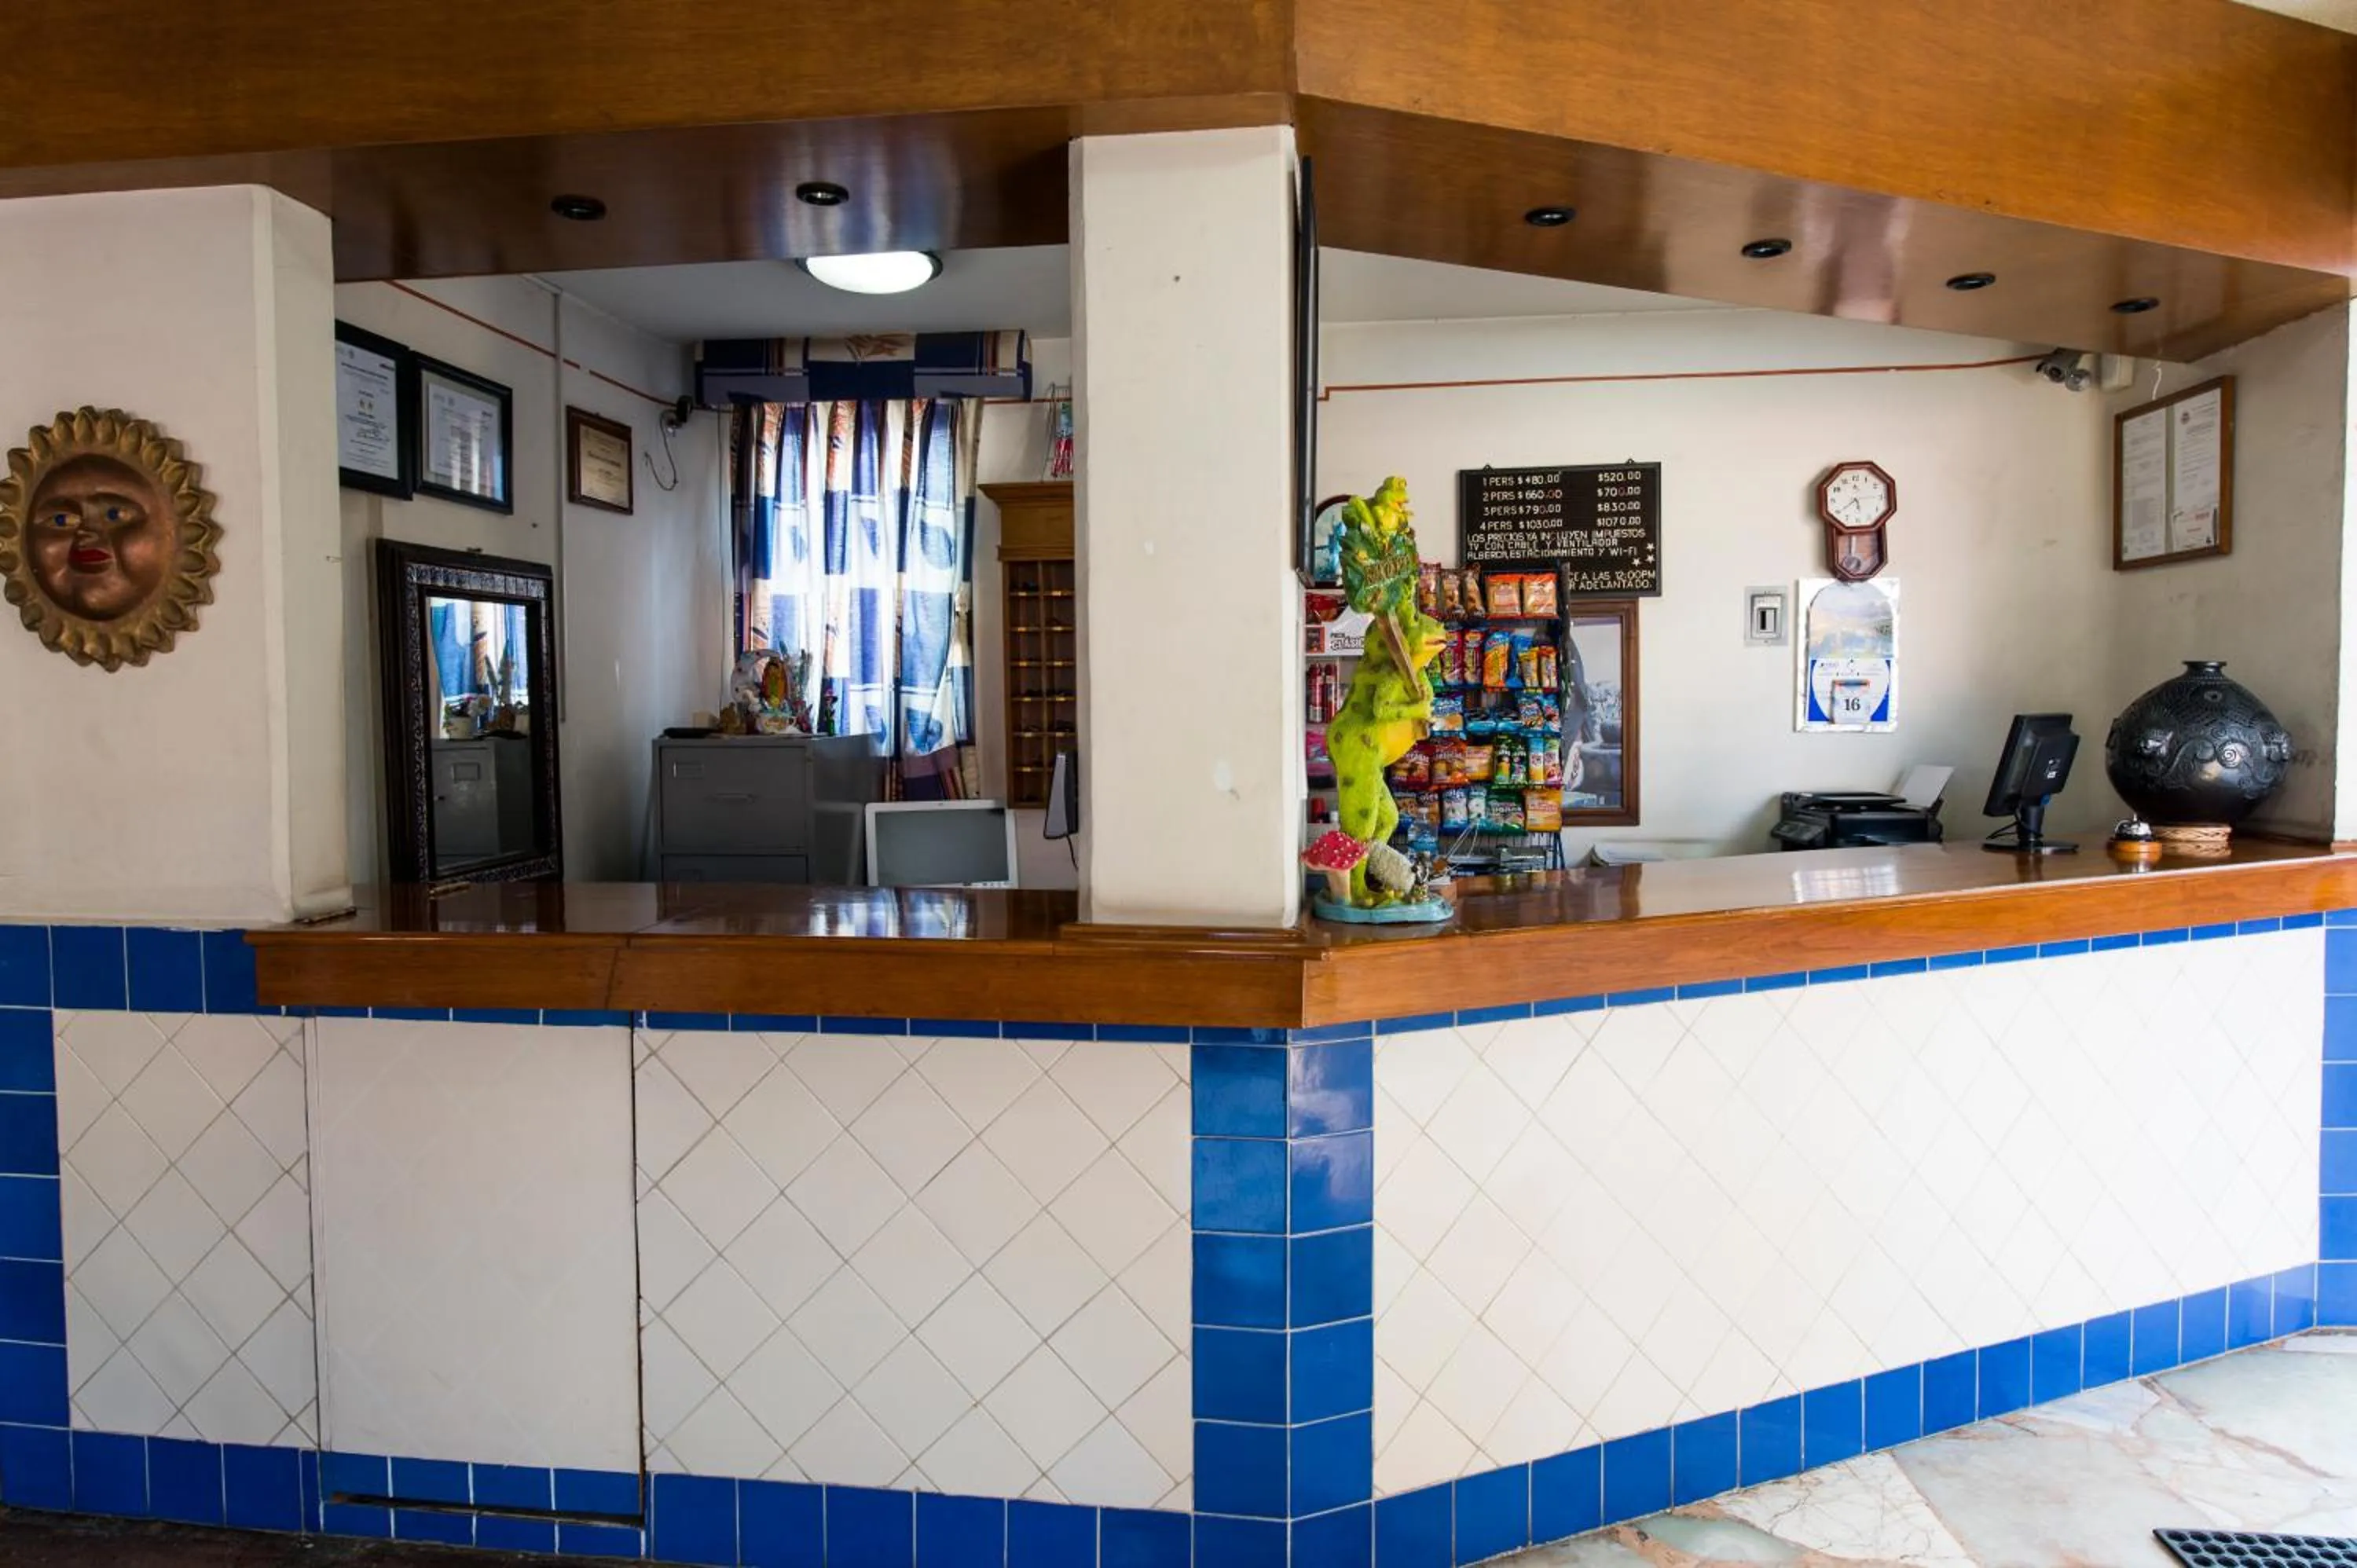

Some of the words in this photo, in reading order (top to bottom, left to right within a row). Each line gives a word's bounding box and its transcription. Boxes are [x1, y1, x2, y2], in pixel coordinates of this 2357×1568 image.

[1489, 475, 1515, 486] PERS
[1598, 471, 1641, 482] $520.00
[1483, 491, 1489, 502] 2
[1490, 491, 1516, 500] PERS
[1597, 486, 1641, 497] $700.00
[1483, 506, 1490, 516] 3
[1490, 505, 1517, 515] PERS
[1479, 521, 1486, 531] 4
[1487, 521, 1512, 531] PERS
[1467, 533, 1485, 543] LOS
[1487, 532, 1525, 543] PRECIOS
[1526, 532, 1538, 541] YA
[1592, 528, 1646, 539] IMPUESTOS
[1468, 542, 1479, 551] TV
[1484, 540, 1505, 551] CON
[1545, 540, 1552, 549] Y
[1556, 537, 1618, 548] VENTILADOR
[1599, 548, 1604, 556] Y
[1582, 571, 1589, 580] A
[1593, 571, 1611, 581] LAS
[1843, 696, 1861, 711] 16
